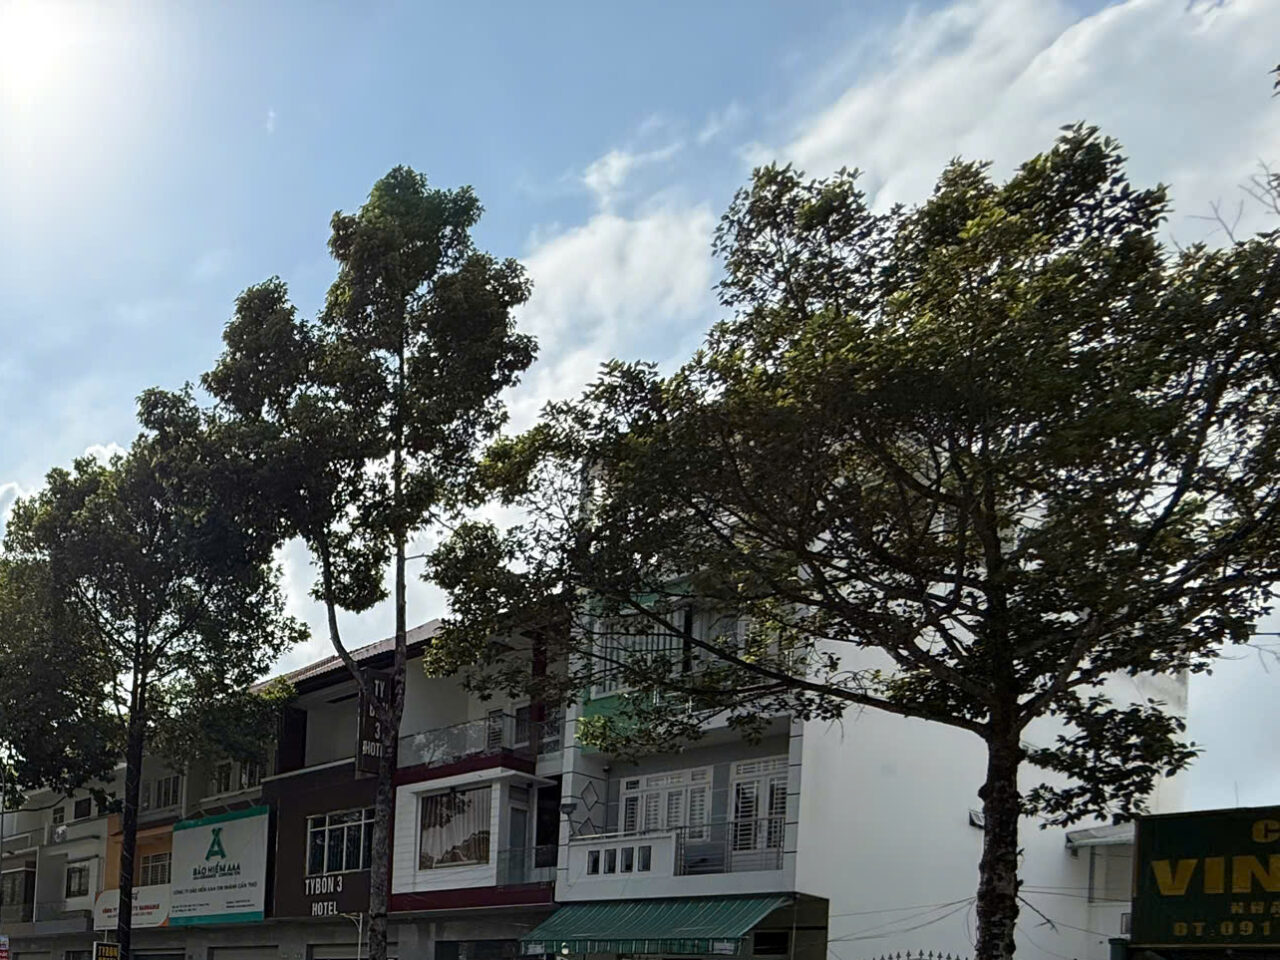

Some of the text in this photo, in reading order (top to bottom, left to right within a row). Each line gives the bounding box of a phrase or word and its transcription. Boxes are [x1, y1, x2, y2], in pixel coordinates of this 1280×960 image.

[305, 875, 343, 895] TYBON 3
[1150, 854, 1280, 896] VIN
[312, 901, 338, 916] HOTEL
